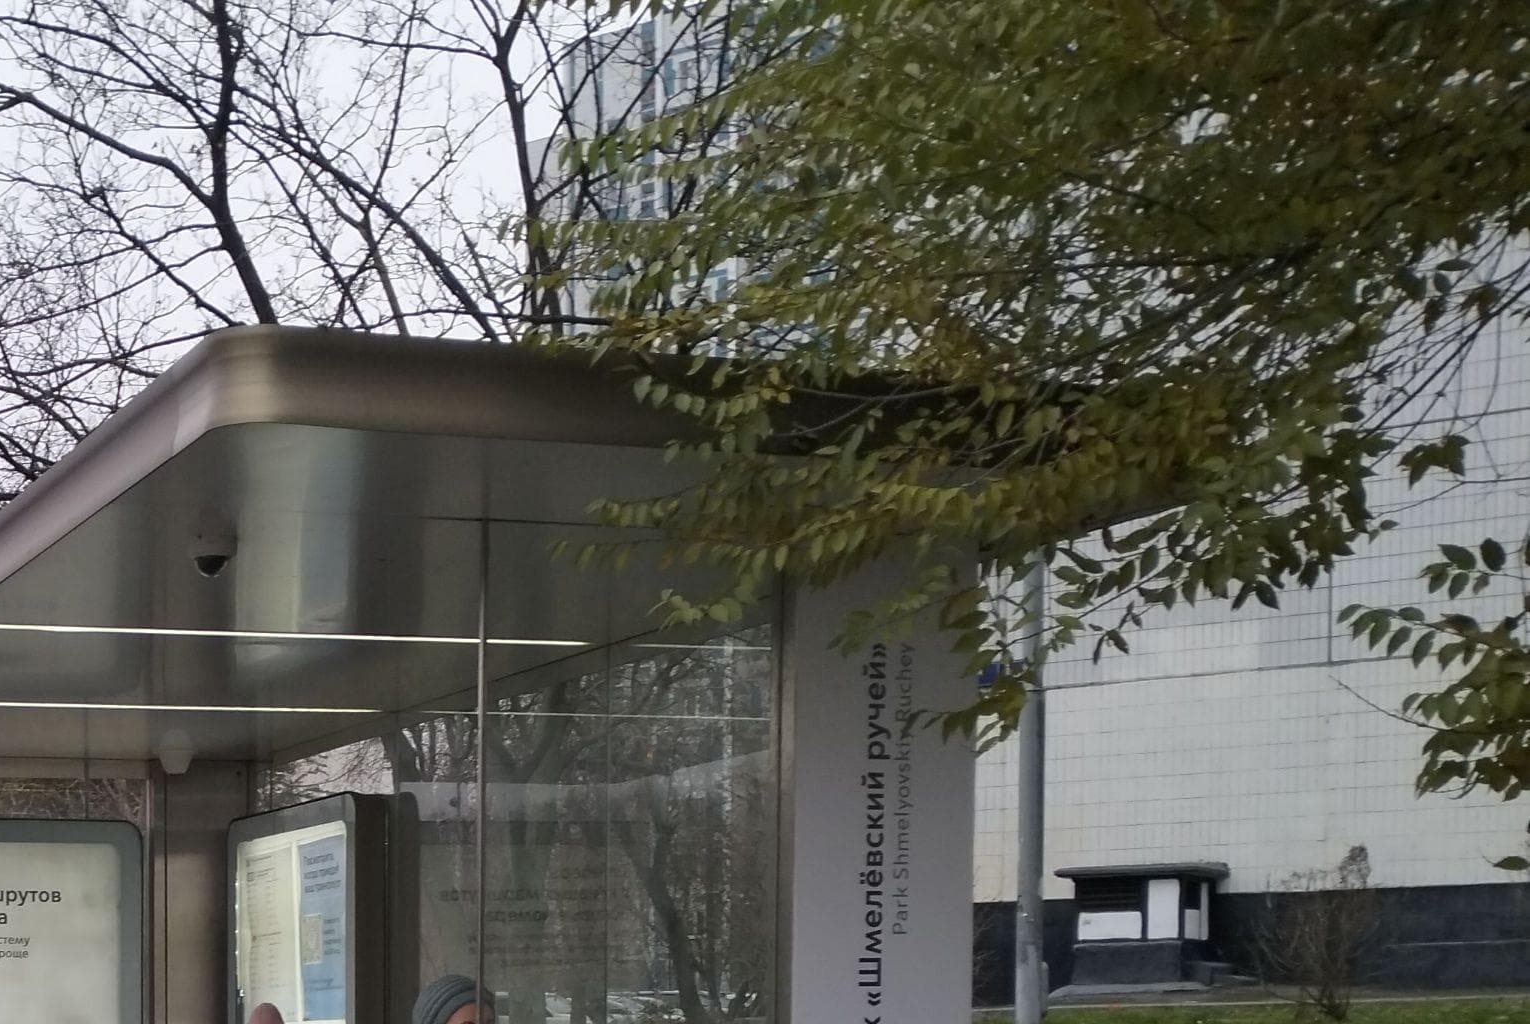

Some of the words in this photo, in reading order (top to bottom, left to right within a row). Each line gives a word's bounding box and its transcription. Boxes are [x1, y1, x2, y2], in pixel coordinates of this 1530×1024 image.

[862, 642, 891, 760] ручей»
[894, 642, 916, 722] Ruchey
[858, 771, 886, 1007] «Шмелёвский
[891, 887, 910, 935] Park
